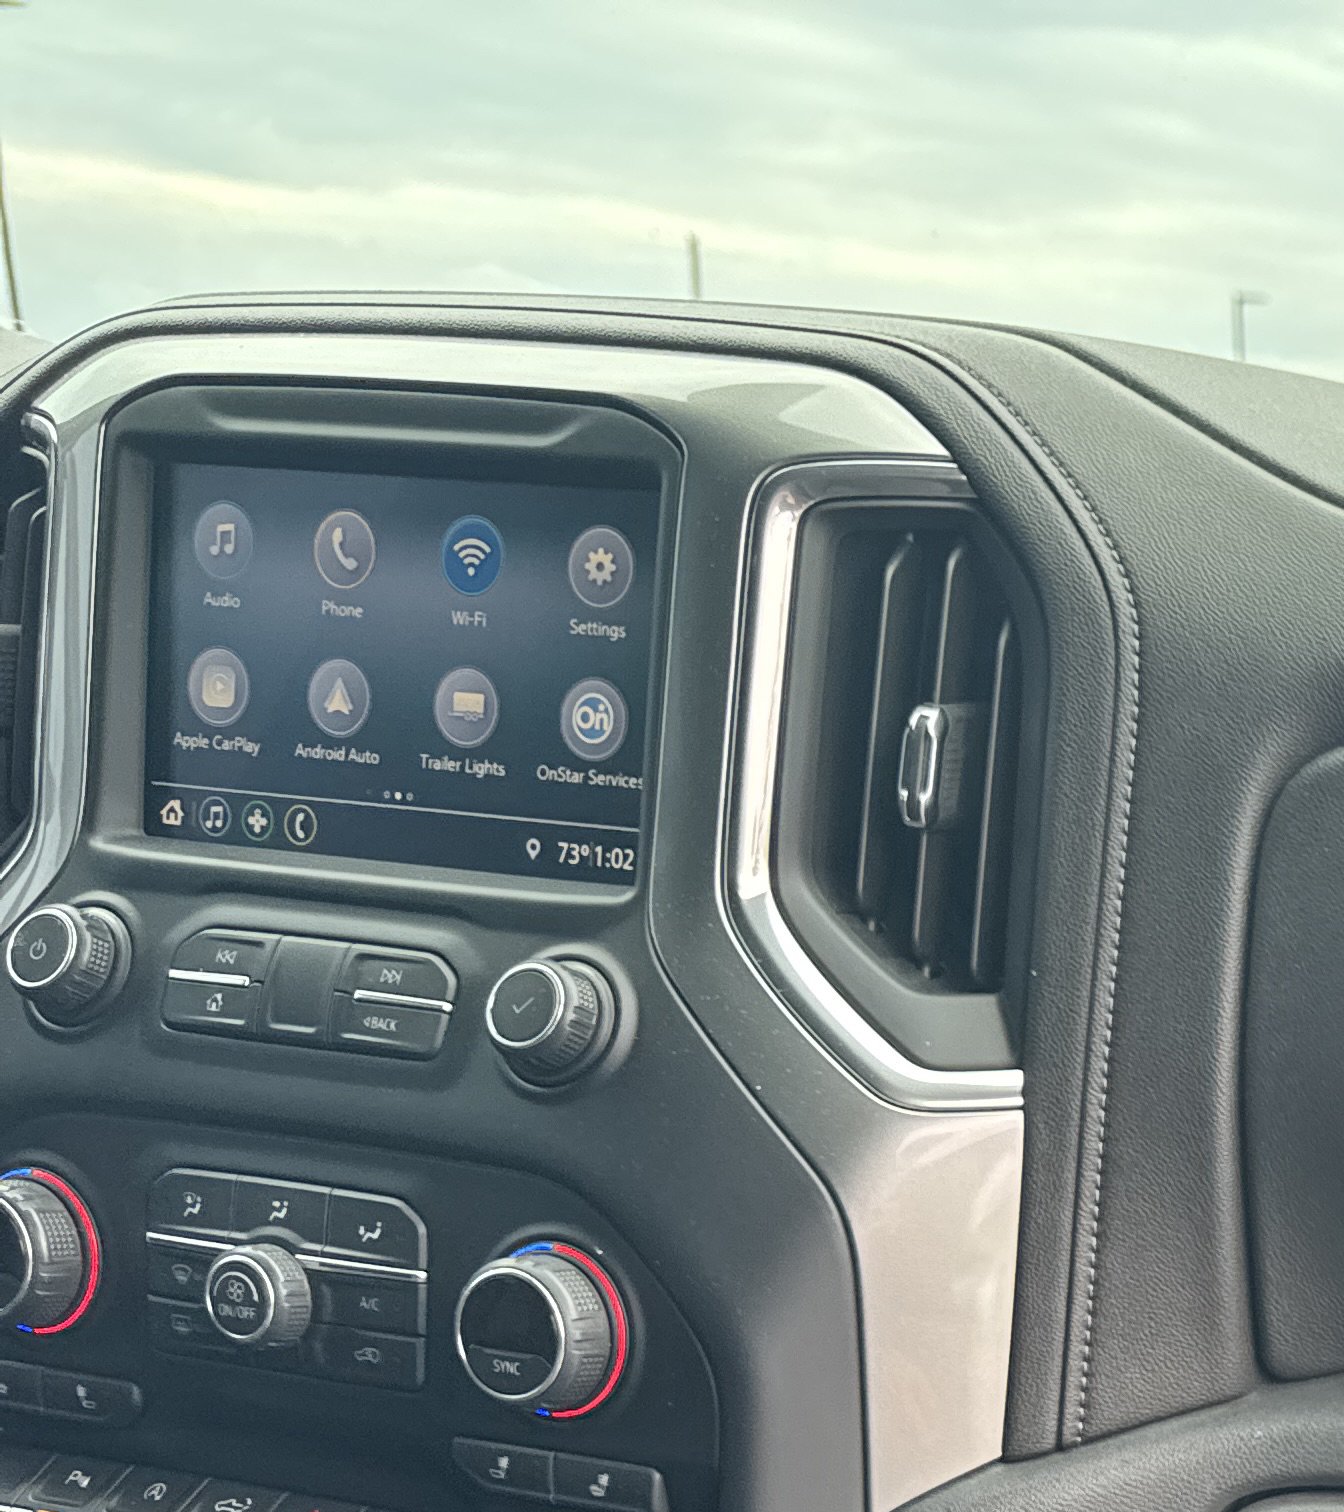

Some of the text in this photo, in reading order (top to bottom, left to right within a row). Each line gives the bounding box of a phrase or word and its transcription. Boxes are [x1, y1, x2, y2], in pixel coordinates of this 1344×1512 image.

[203, 592, 241, 609] Audio
[321, 600, 364, 618] Phone
[451, 610, 487, 627] Wi-Fi
[569, 618, 626, 641] Settings
[173, 732, 261, 757] Apple CarPlay
[294, 743, 380, 765] Android Auto
[420, 754, 506, 778] Trailer Lights
[536, 764, 586, 784] OnStar
[594, 845, 635, 871] 1:02
[371, 1016, 399, 1031] BACK
[217, 1303, 257, 1320] ON/OFF
[359, 1296, 380, 1312] A/C
[492, 1359, 521, 1376] SYNC
